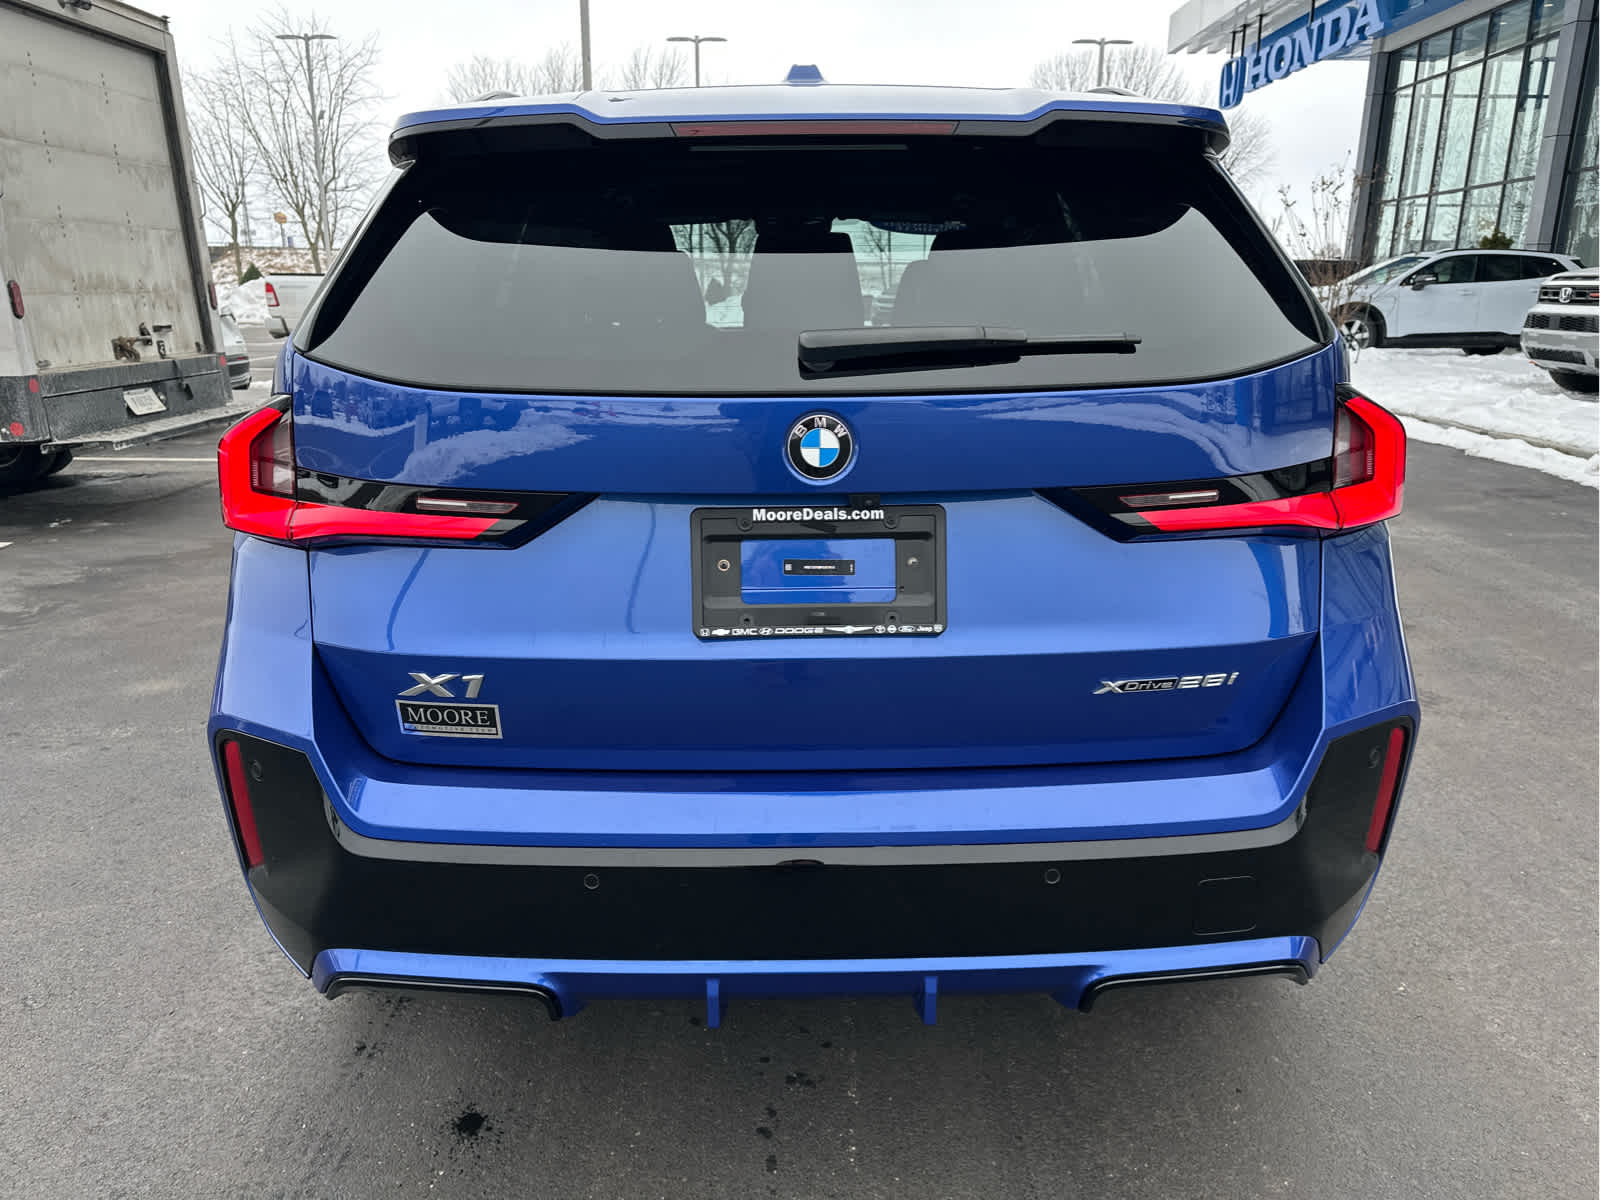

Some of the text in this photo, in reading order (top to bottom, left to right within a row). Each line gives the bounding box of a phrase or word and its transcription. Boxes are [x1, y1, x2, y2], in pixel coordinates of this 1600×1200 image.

[1244, 0, 1384, 93] HONDA
[794, 417, 848, 438] BMW
[752, 507, 884, 521] MooreDeals.com
[731, 627, 758, 636] GMC
[774, 626, 824, 635] DODGE
[397, 672, 485, 699] X1
[407, 706, 491, 725] MOORE
